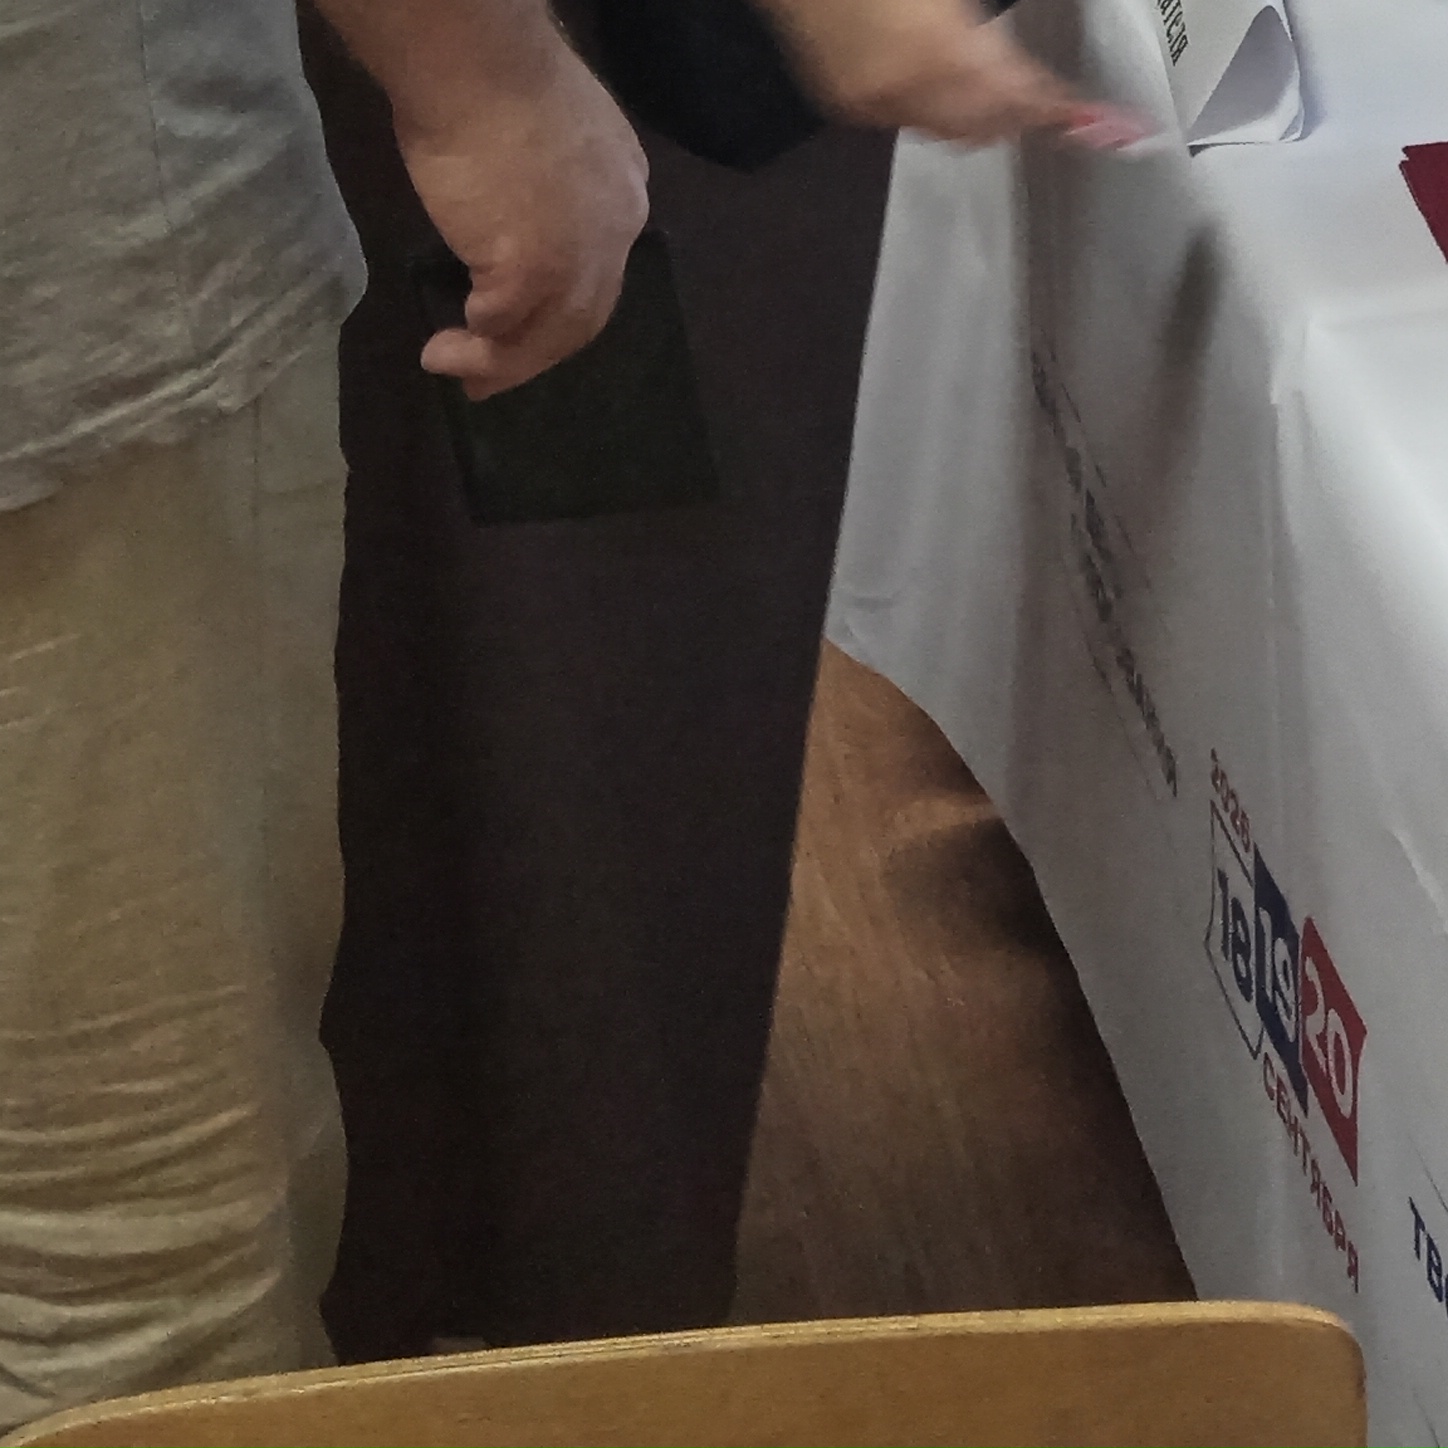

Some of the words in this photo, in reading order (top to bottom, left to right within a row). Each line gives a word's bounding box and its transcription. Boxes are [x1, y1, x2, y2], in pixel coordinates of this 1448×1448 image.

[1210, 747, 1250, 856] 2026
[1216, 867, 1253, 1004] 18
[1259, 906, 1297, 1044] 19
[1304, 955, 1353, 1121] 20
[1263, 1051, 1360, 1294] СЕНТЯБРЯ
